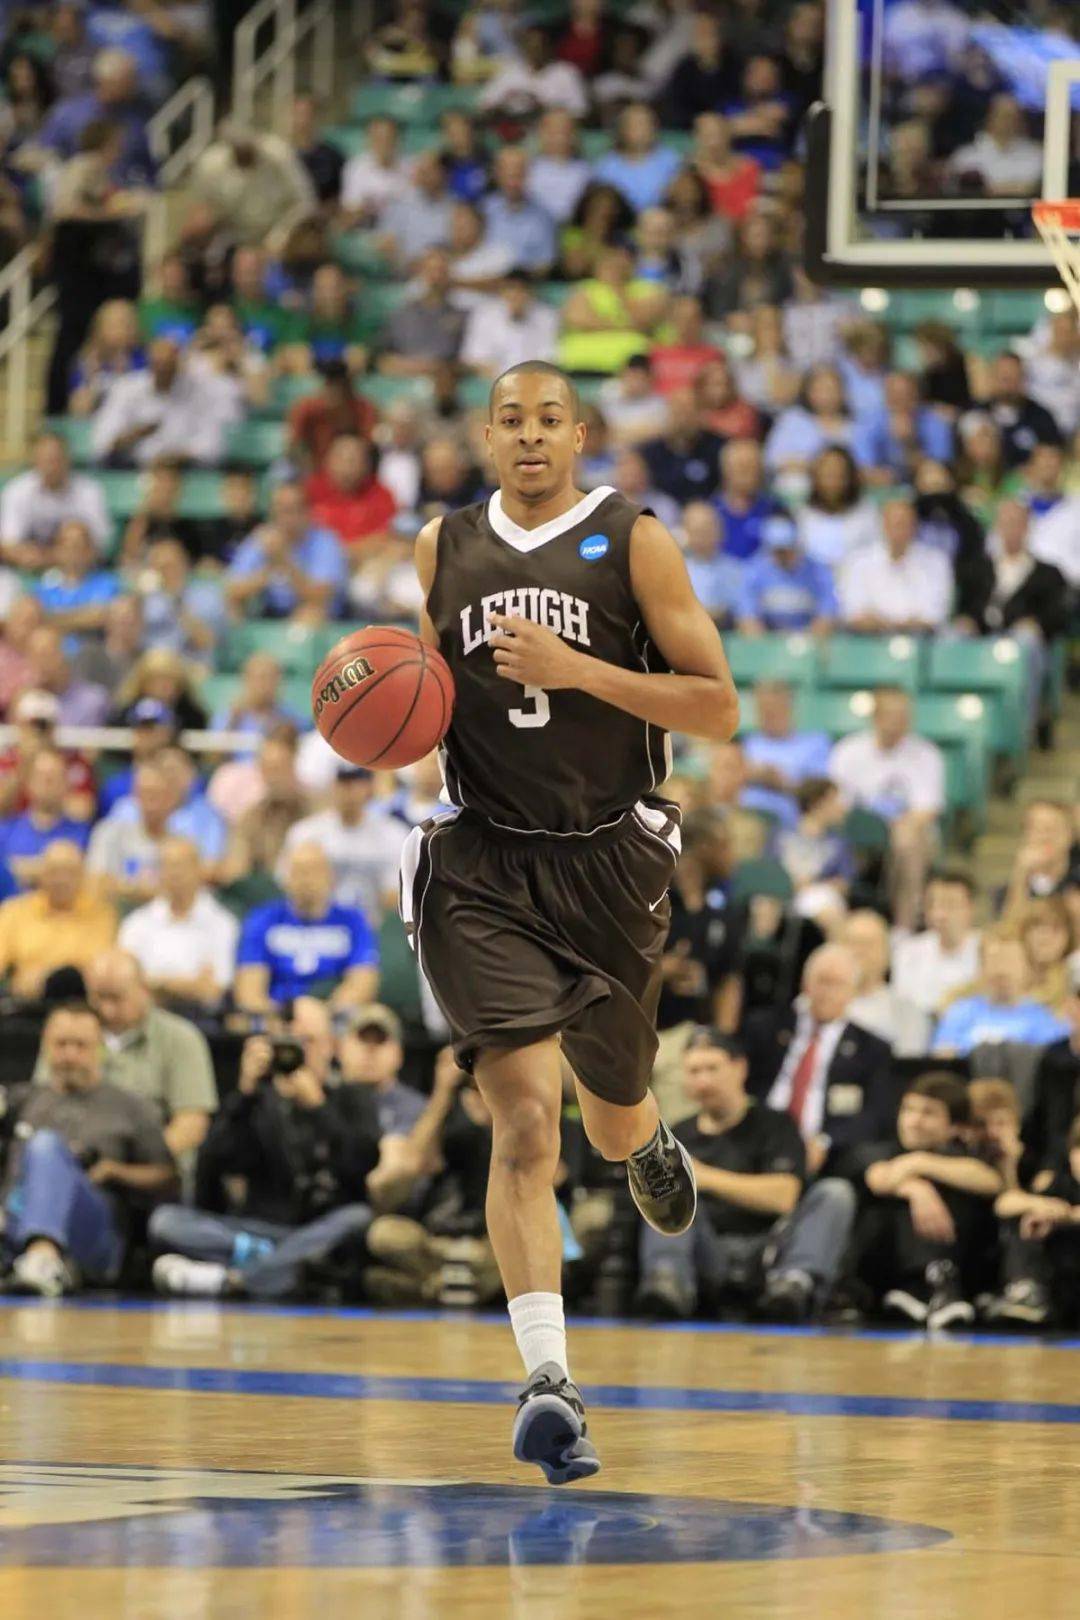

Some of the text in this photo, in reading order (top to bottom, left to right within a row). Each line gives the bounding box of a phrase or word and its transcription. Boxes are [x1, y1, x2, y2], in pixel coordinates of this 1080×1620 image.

[582, 544, 607, 555] NCAA
[460, 587, 591, 656] LEHIGH
[313, 656, 376, 716] Wilso
